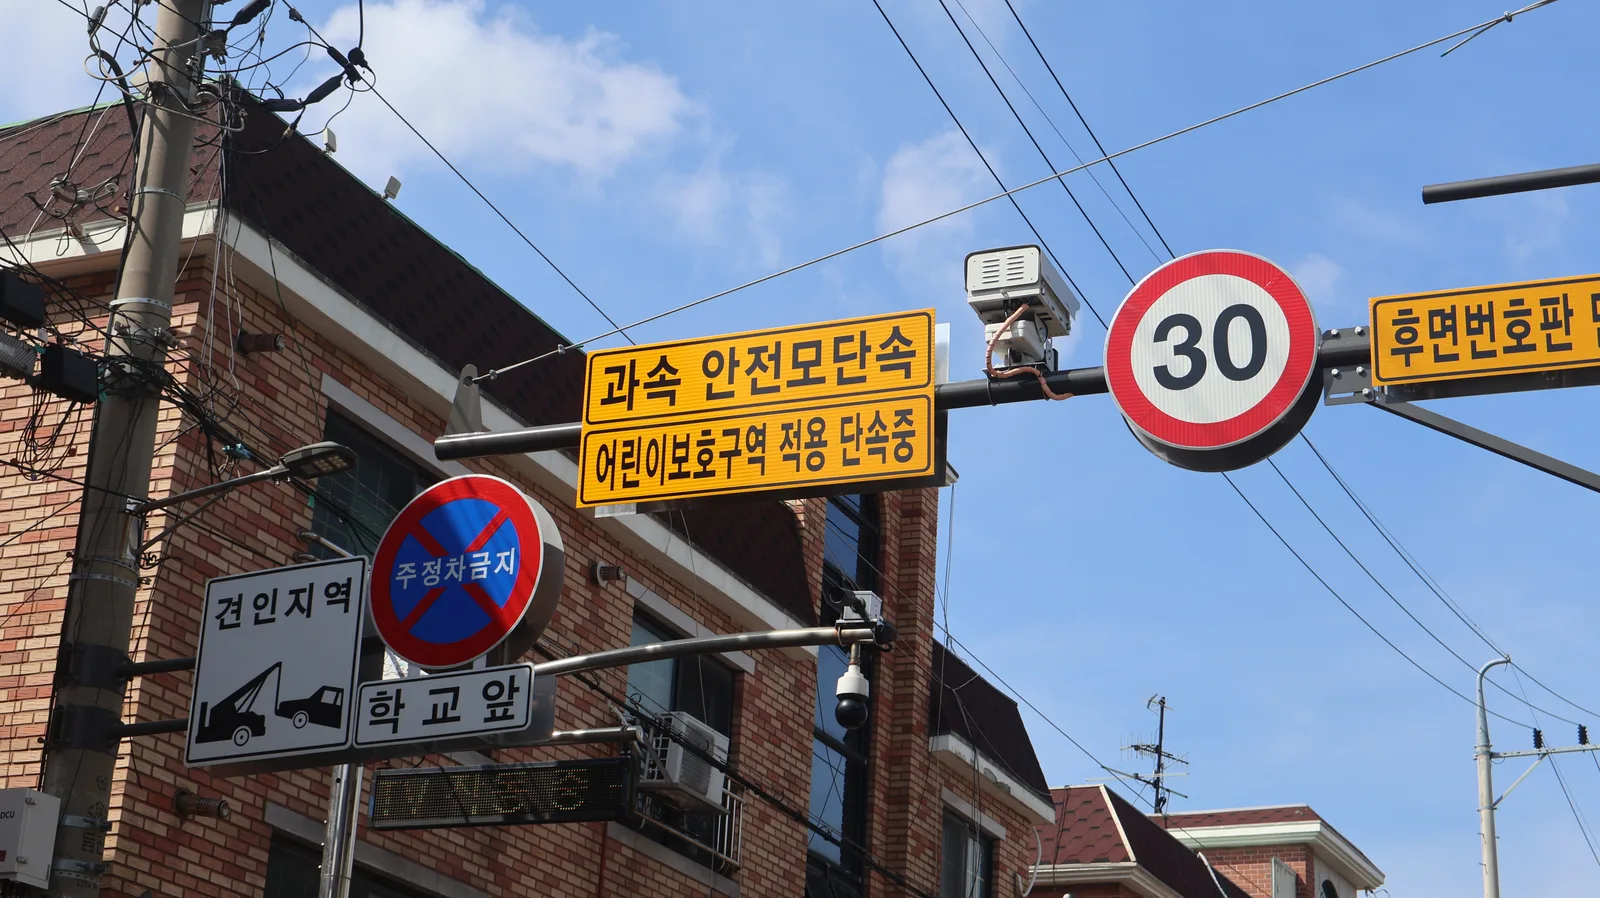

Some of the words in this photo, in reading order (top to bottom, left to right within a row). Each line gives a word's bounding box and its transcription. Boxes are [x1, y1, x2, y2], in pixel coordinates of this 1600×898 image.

[601, 355, 681, 411] 과속
[702, 326, 916, 400] 안전모단속
[1152, 303, 1268, 391] 30
[1391, 293, 1573, 367] 후면번호판
[596, 423, 766, 491] 어린이보호구역
[780, 417, 827, 472] 적용
[841, 409, 915, 466] 단속중
[215, 577, 352, 630] 견인지역
[395, 547, 516, 590] 주정차금지
